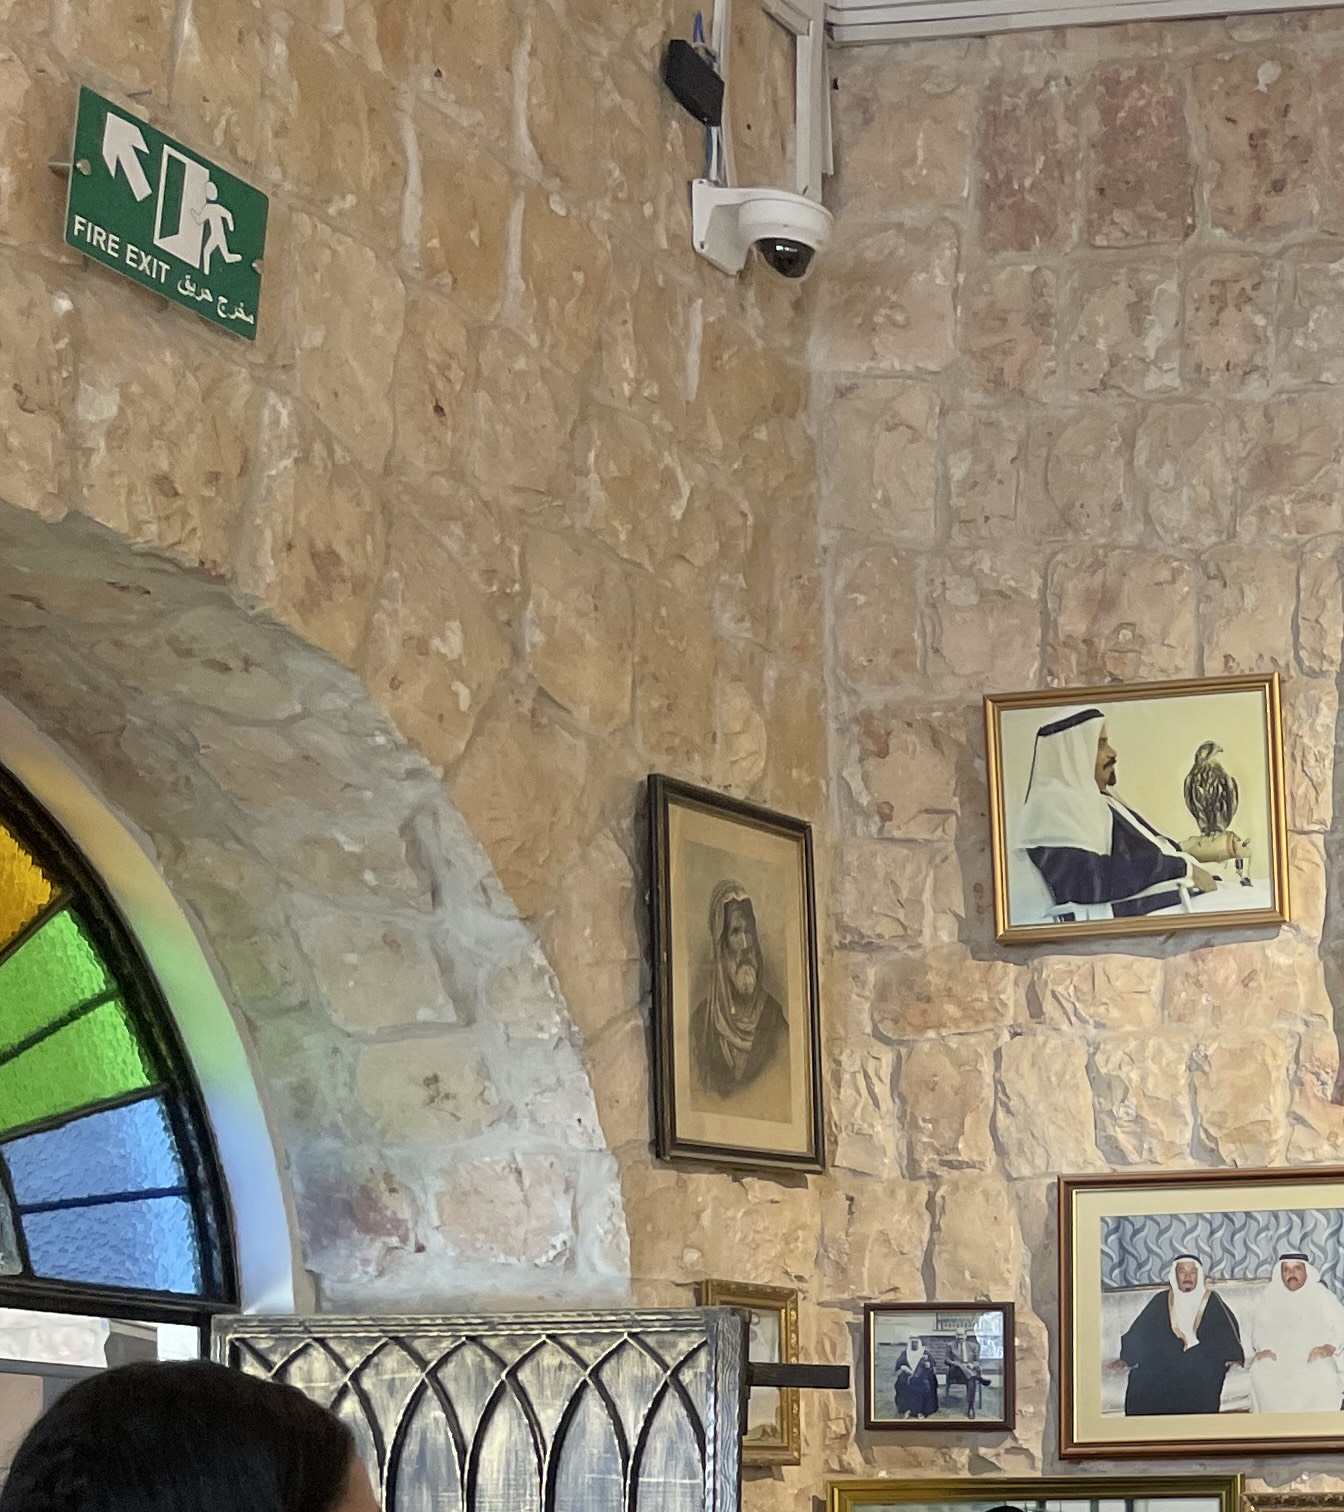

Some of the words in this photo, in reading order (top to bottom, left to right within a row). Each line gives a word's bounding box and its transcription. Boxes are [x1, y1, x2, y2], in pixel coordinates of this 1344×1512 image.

[73, 214, 121, 258] FIRE
[125, 243, 171, 284] EXIT
[177, 274, 214, 302] حريق
[217, 296, 255, 324] مخرج
